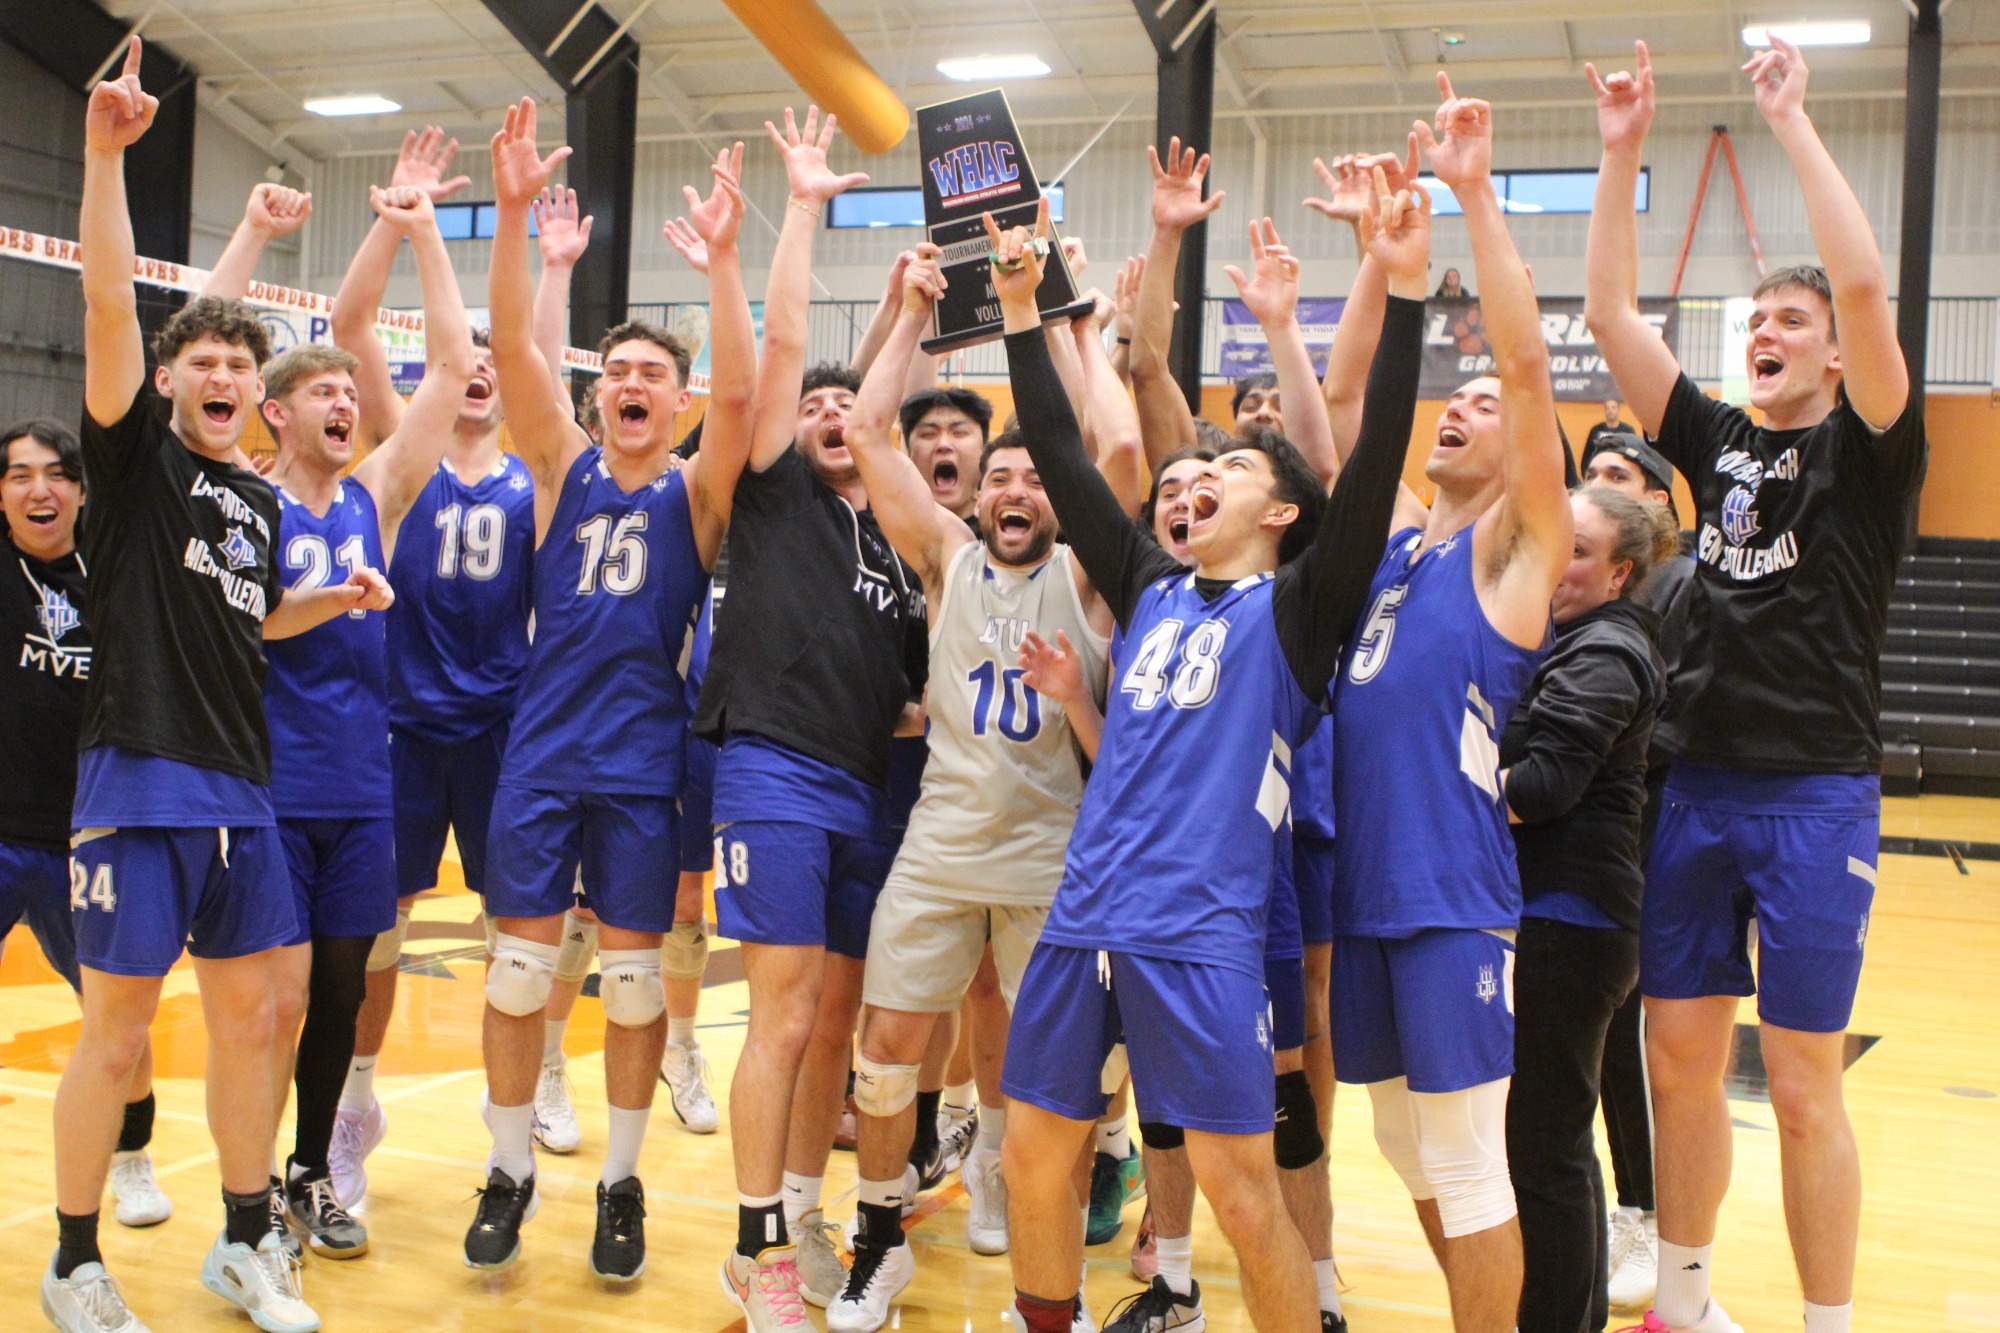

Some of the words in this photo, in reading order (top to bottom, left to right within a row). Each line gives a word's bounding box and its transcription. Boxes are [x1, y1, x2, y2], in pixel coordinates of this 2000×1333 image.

[929, 141, 1020, 198] WHAC
[285, 534, 367, 620] 21
[435, 502, 507, 582] 19
[575, 510, 649, 596] 15
[978, 614, 1029, 652] LTU
[1120, 616, 1231, 711] 48
[1349, 585, 1409, 685] 5
[967, 660, 1042, 742] 10
[72, 861, 118, 913] 24
